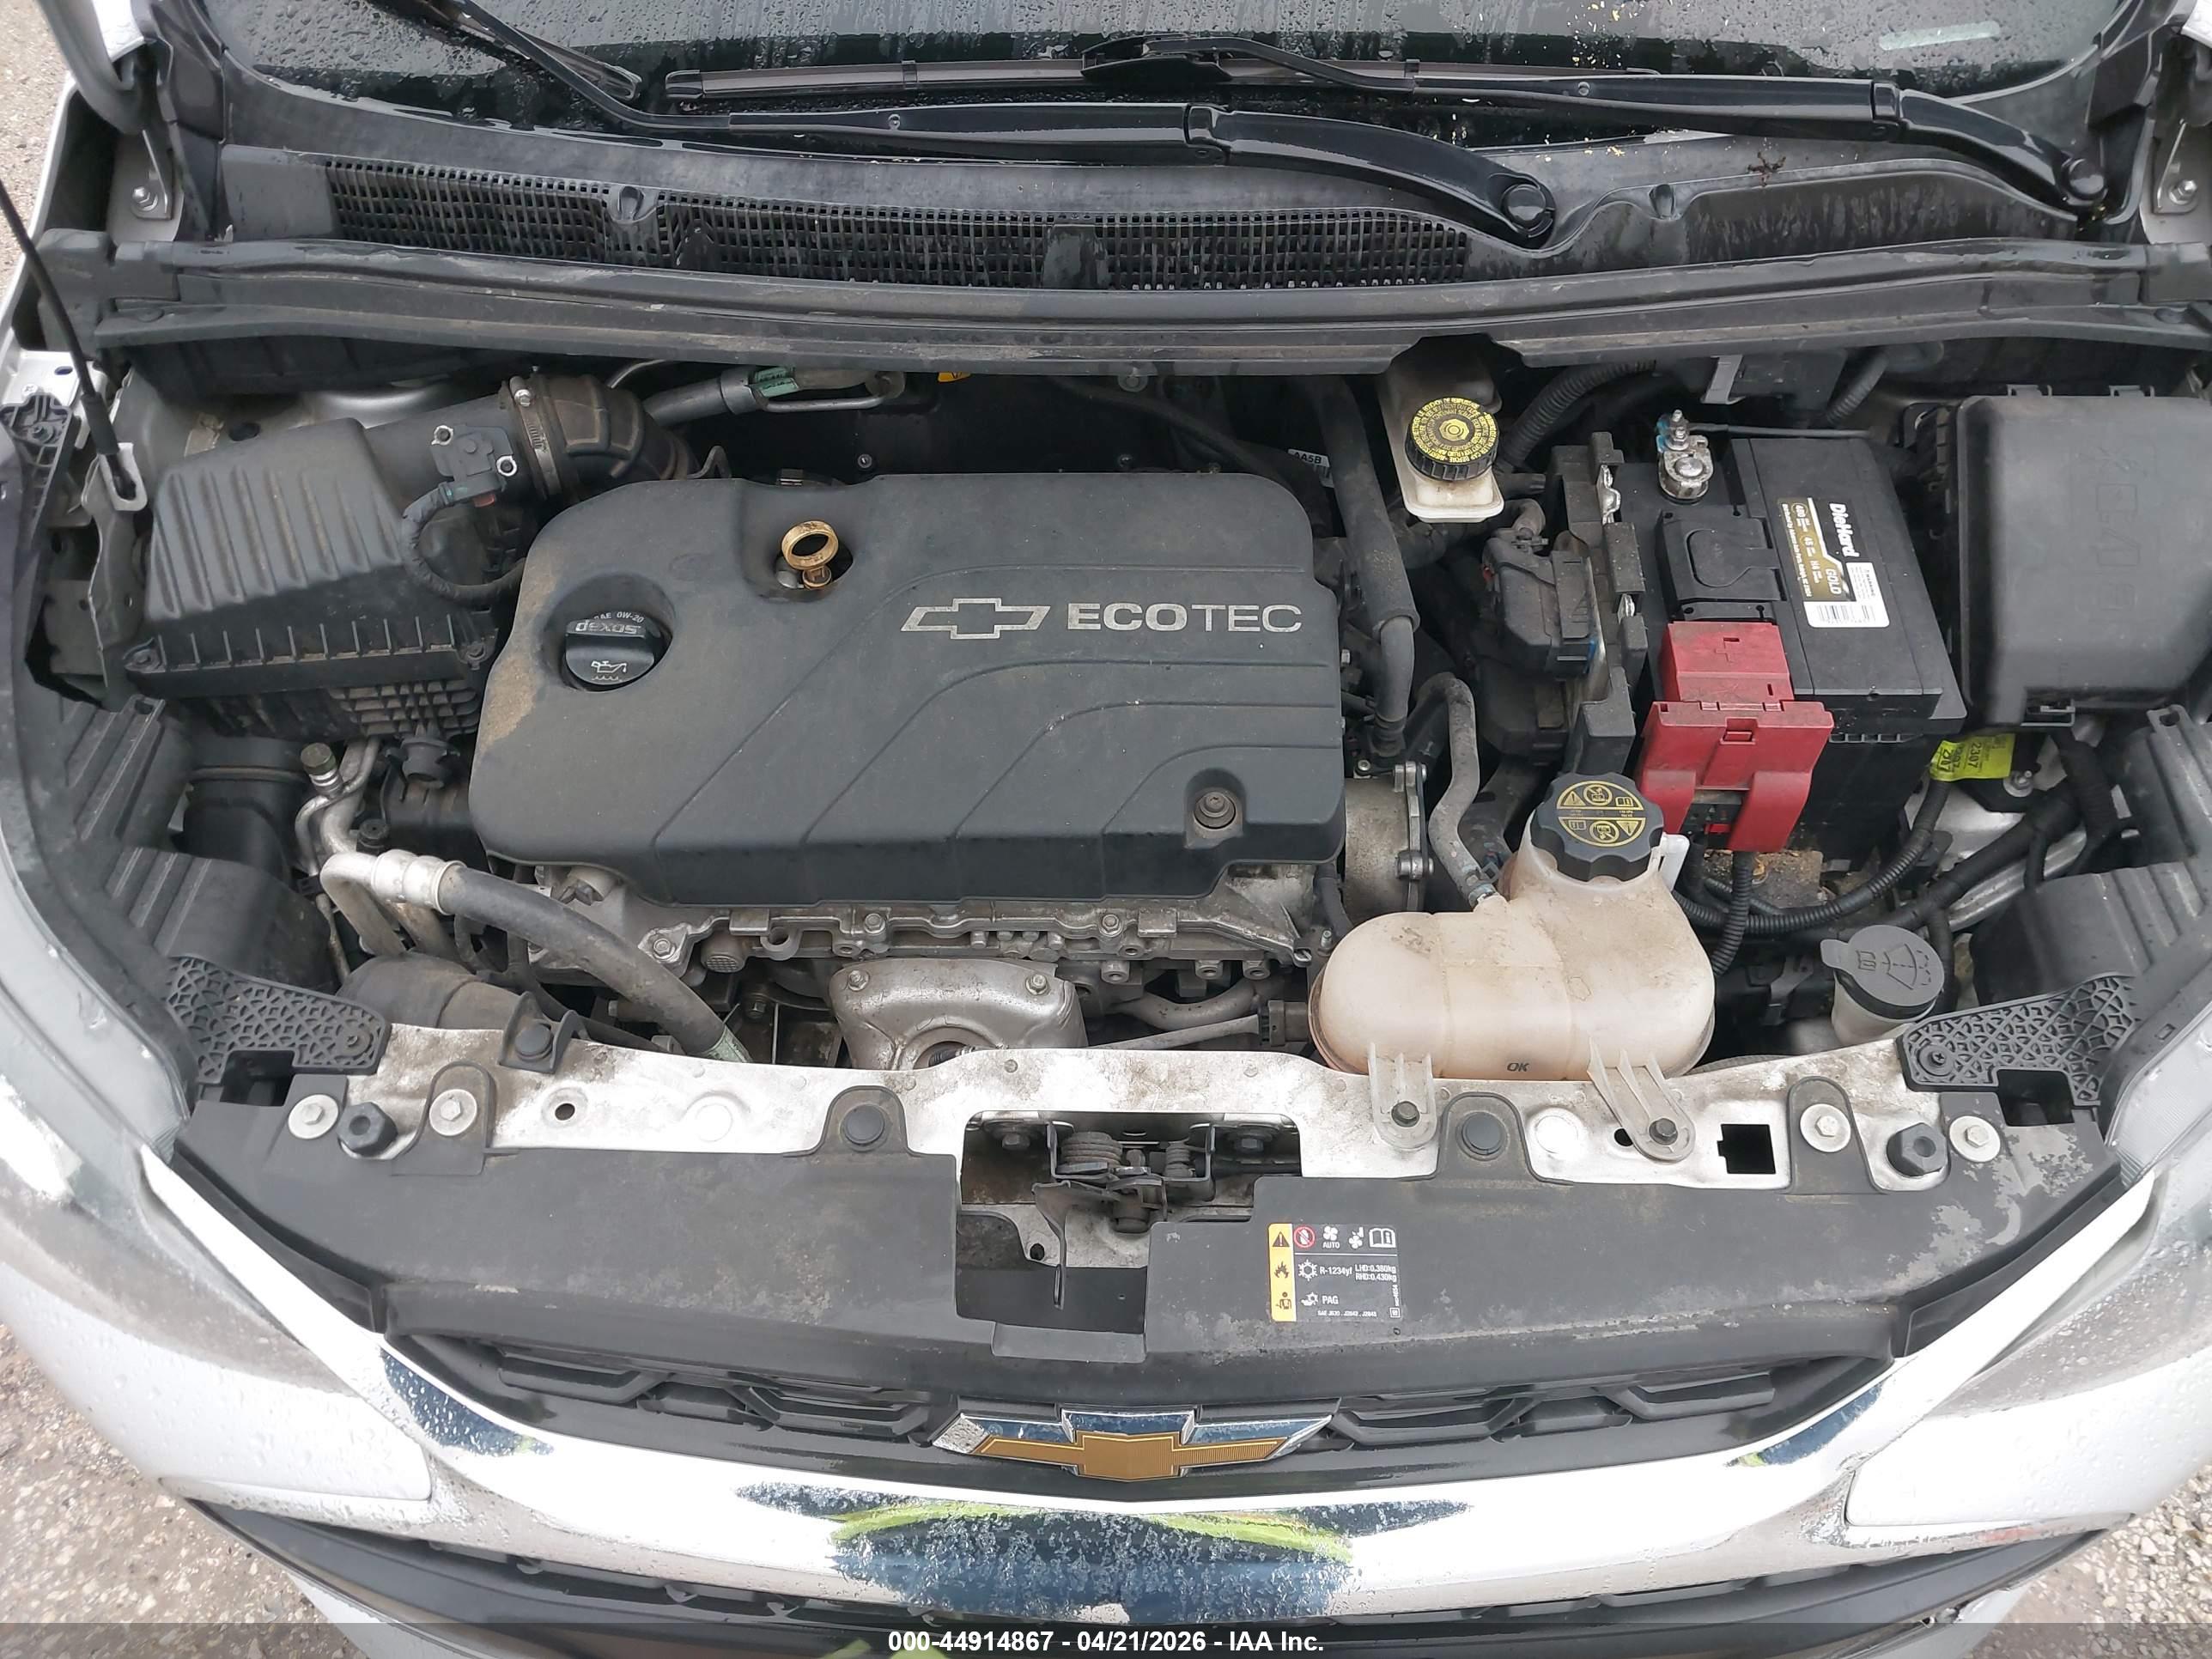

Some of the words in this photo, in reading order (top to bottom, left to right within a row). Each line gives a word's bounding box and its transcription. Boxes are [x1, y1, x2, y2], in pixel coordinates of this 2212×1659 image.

[1829, 502, 1860, 557] DieHard
[1826, 568, 1841, 594] GOLD
[617, 611, 644, 623] 0W-20
[1067, 603, 1302, 632] ECOTEC
[1968, 742, 1982, 769] 2307
[1507, 1062, 1529, 1072] OK
[1319, 1267, 1352, 1277] R-1234yf
[1322, 1295, 1339, 1304] PAG
